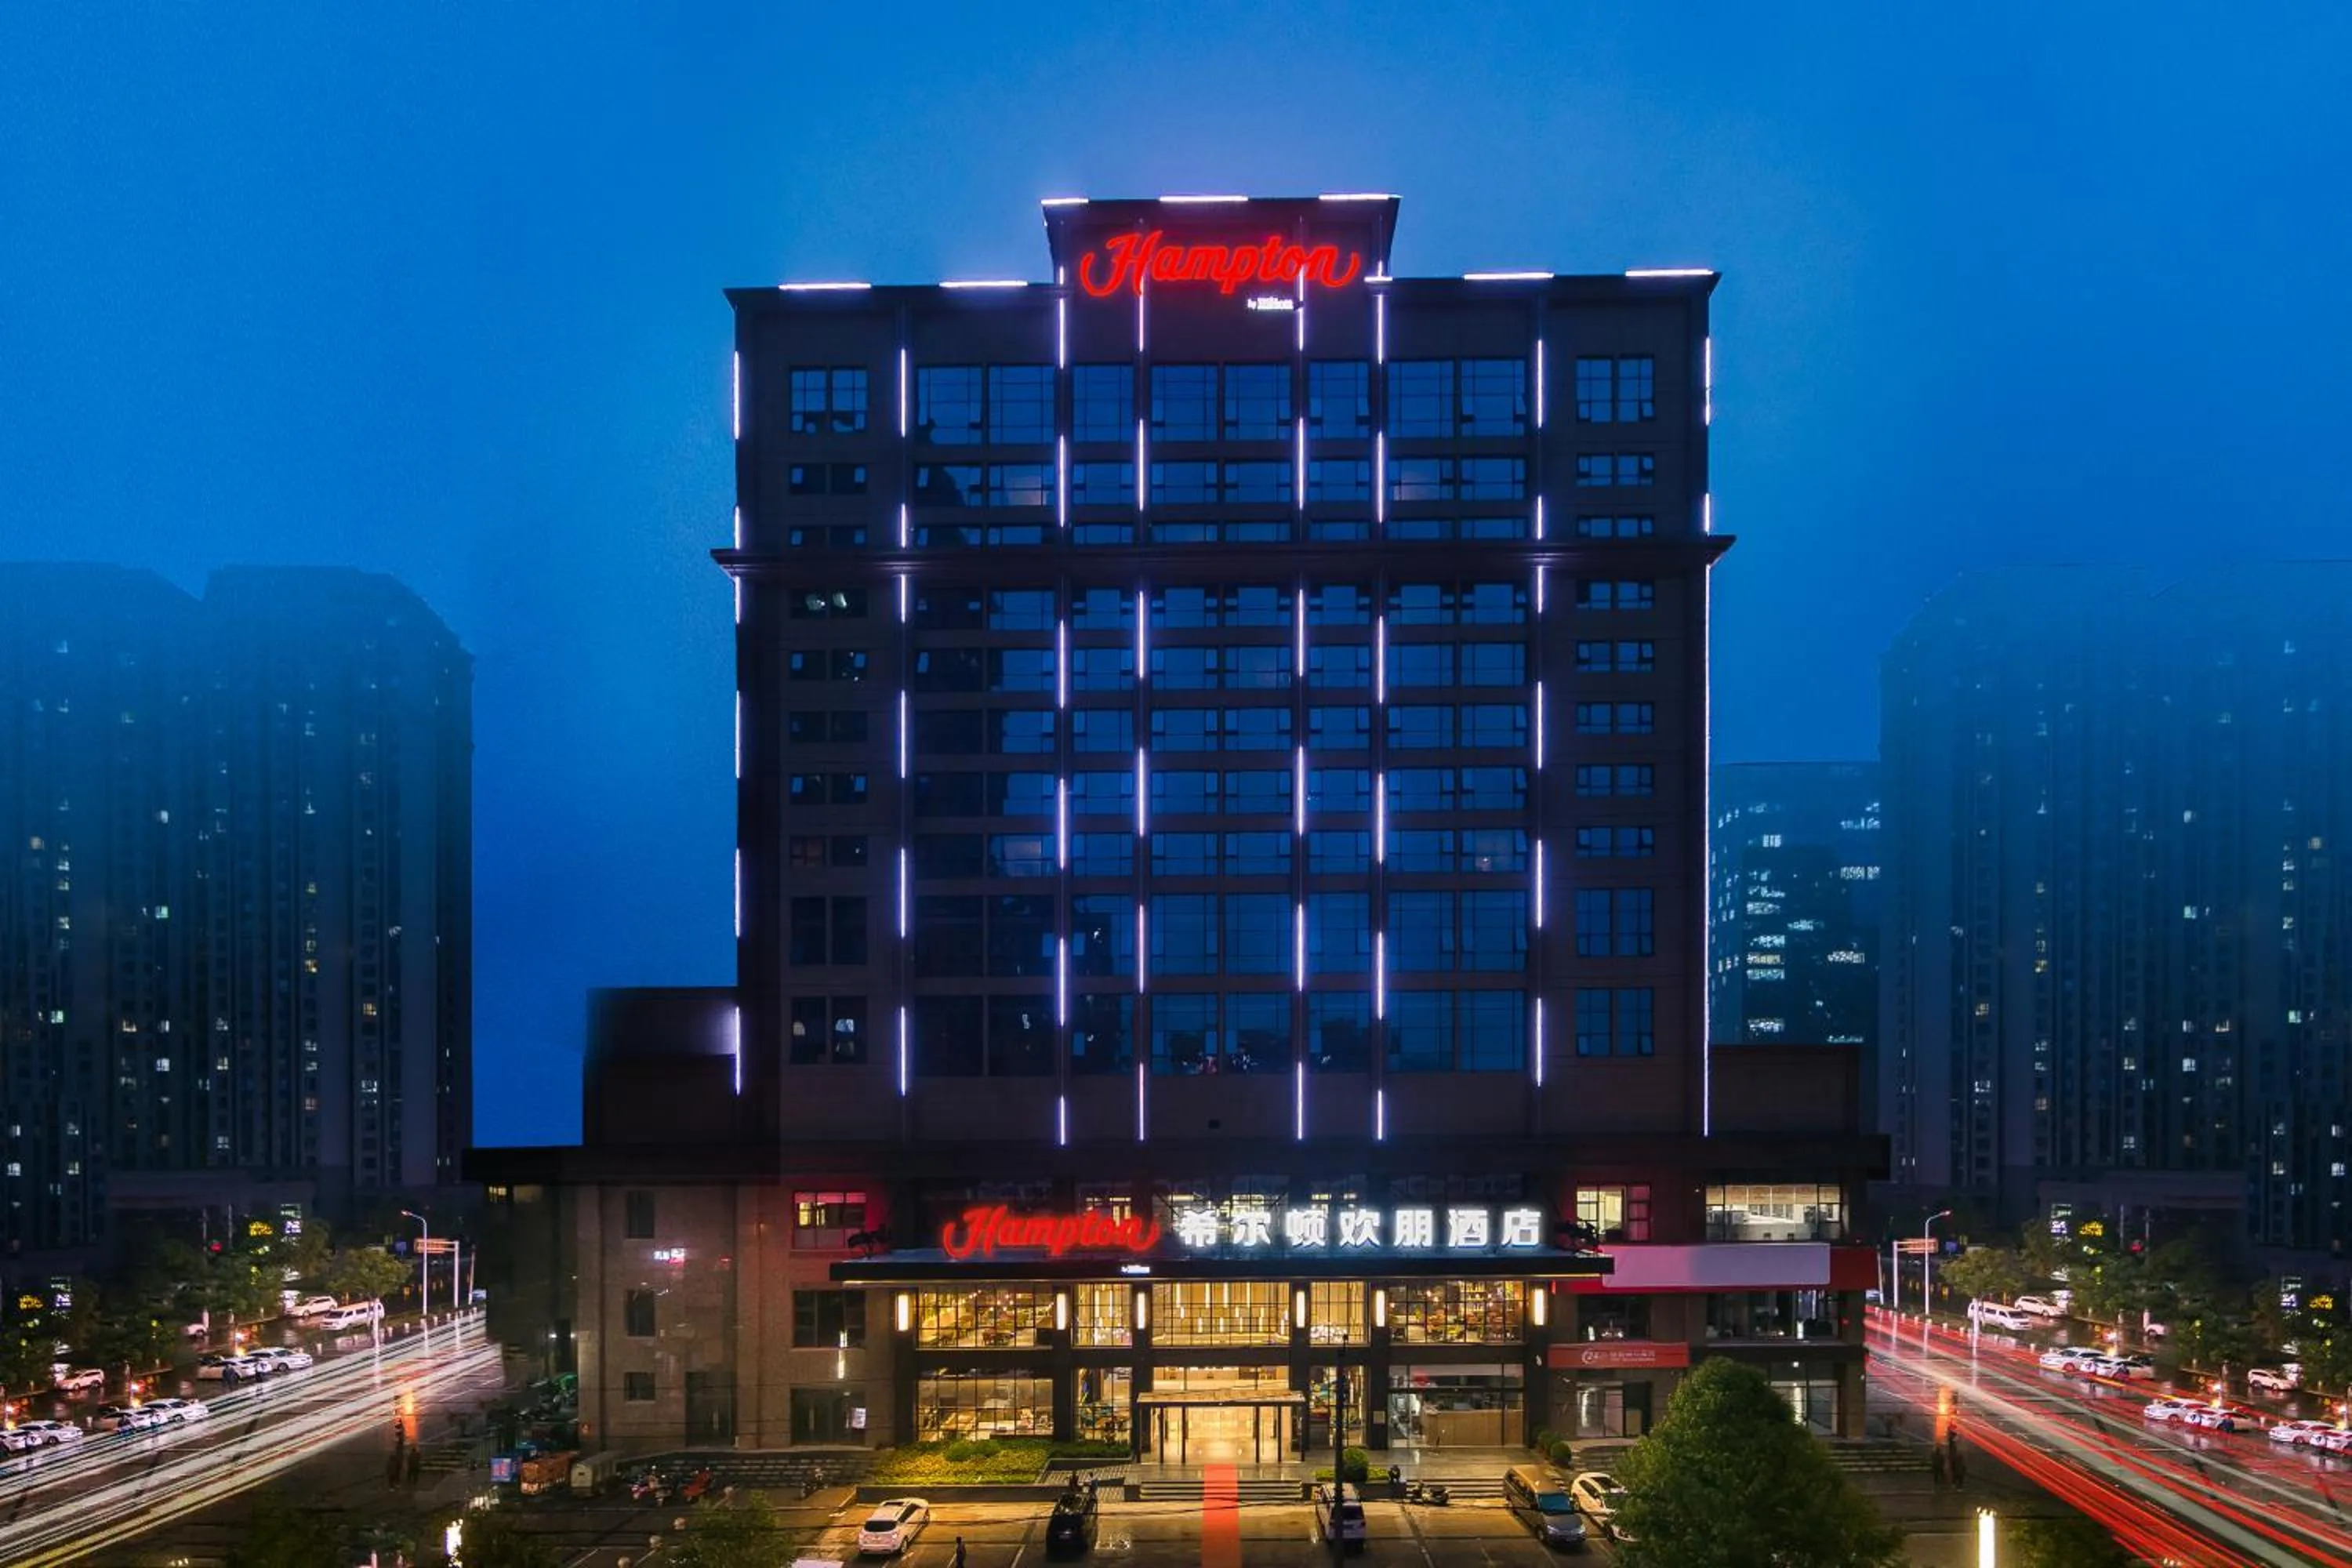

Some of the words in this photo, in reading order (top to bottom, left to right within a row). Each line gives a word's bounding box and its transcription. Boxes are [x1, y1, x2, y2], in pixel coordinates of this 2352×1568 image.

[1080, 230, 1360, 296] Hampton
[943, 1205, 1160, 1258] Hampton
[1178, 1208, 1542, 1247] 希尔顿欢朋酒店
